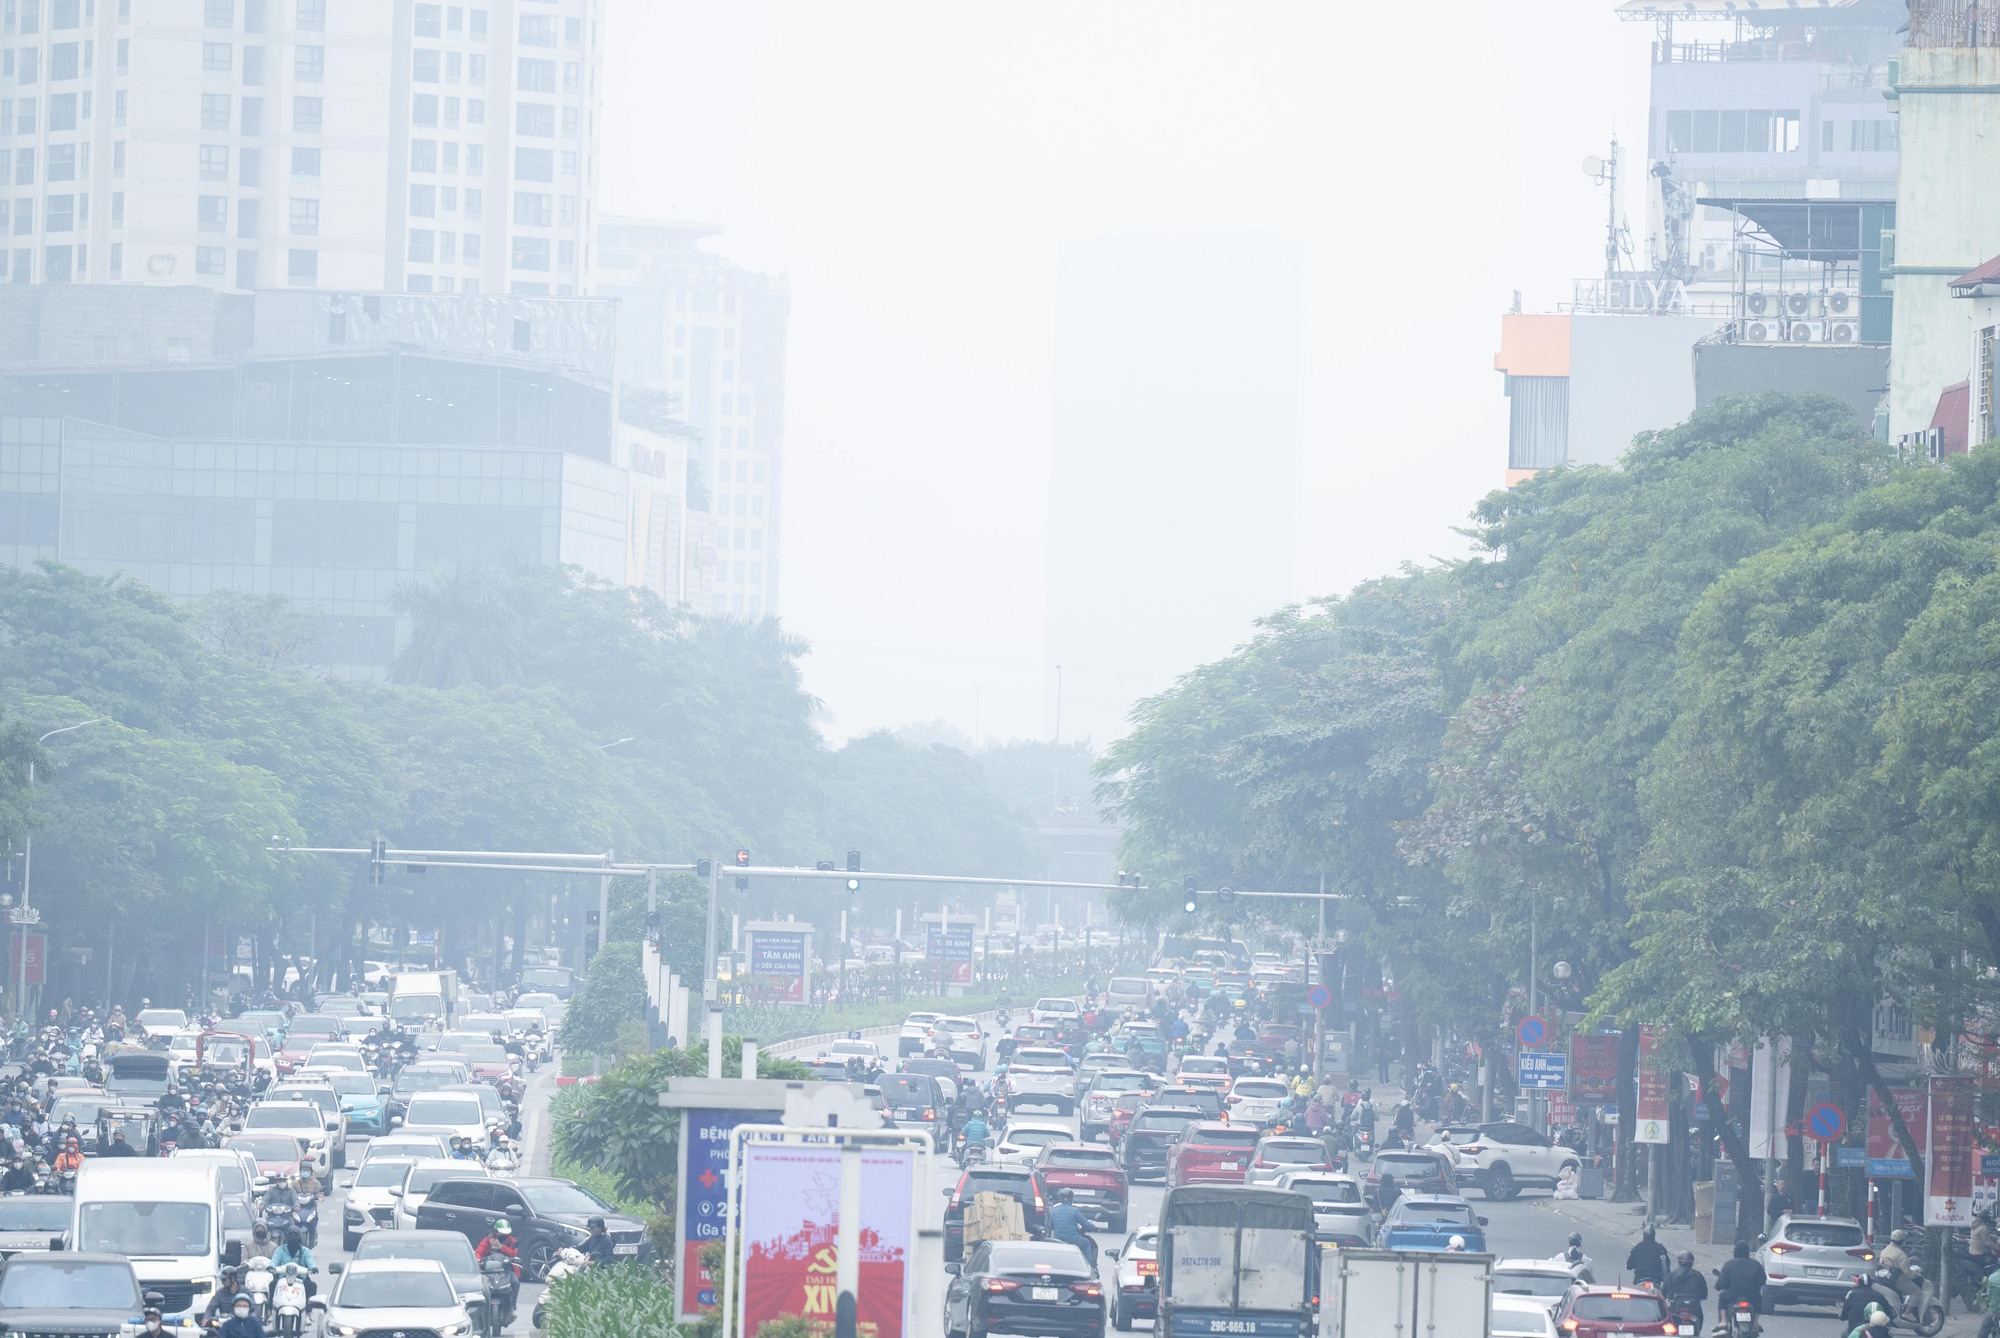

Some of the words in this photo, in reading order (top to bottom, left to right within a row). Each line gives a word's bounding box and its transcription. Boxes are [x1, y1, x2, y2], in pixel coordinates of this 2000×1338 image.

[763, 950, 781, 959] TÂM
[782, 952, 801, 960] ANH
[1535, 1059, 1547, 1071] ANH
[697, 1222, 719, 1238] (Ga
[1210, 1320, 1256, 1334] 29C-669.16
